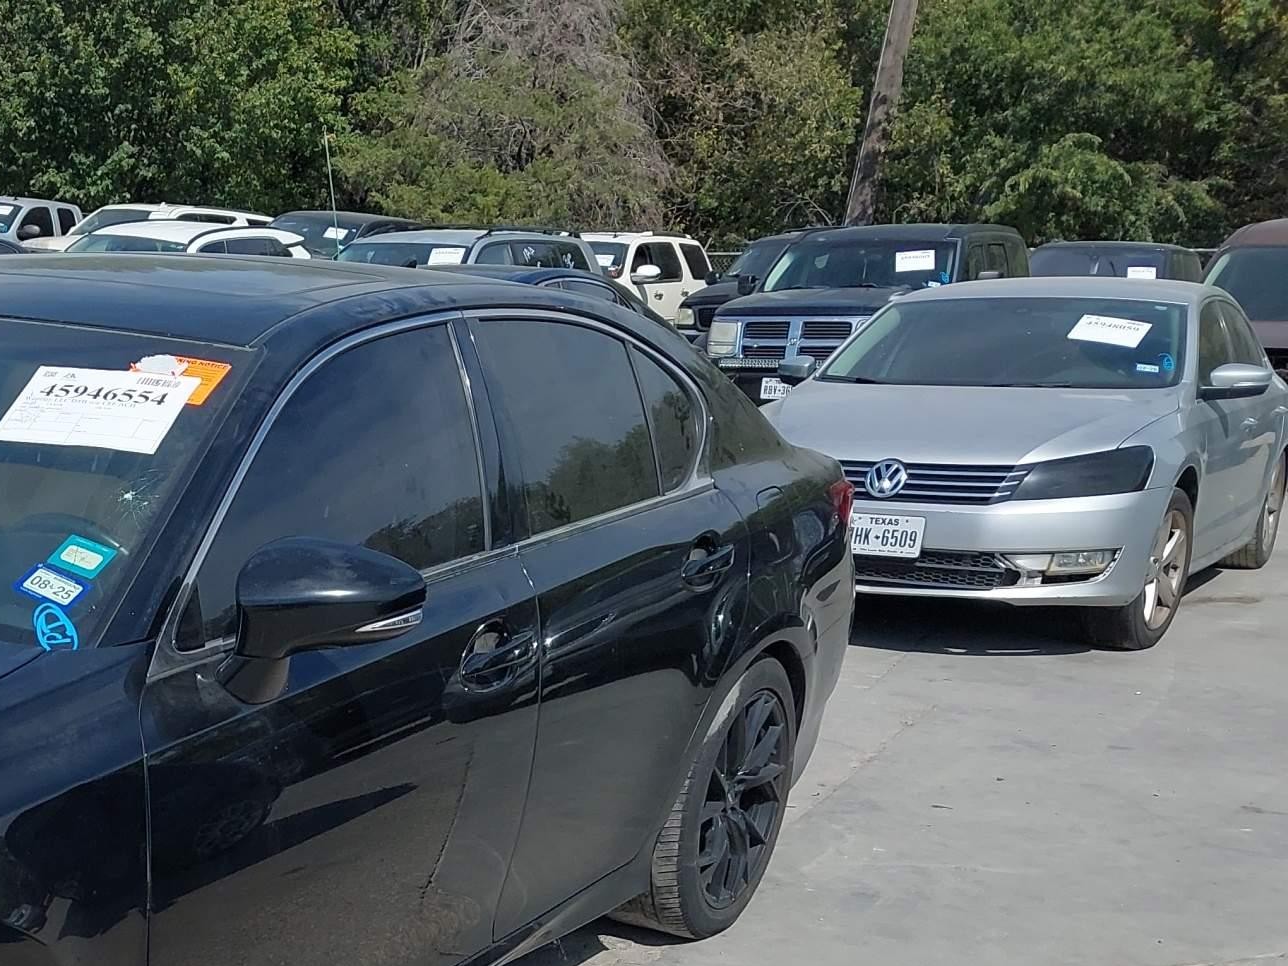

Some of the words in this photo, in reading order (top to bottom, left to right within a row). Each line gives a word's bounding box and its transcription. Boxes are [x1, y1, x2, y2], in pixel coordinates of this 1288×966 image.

[198, 361, 229, 370] NOTICE
[39, 383, 169, 406] 45946554
[869, 517, 900, 526] TEXAS
